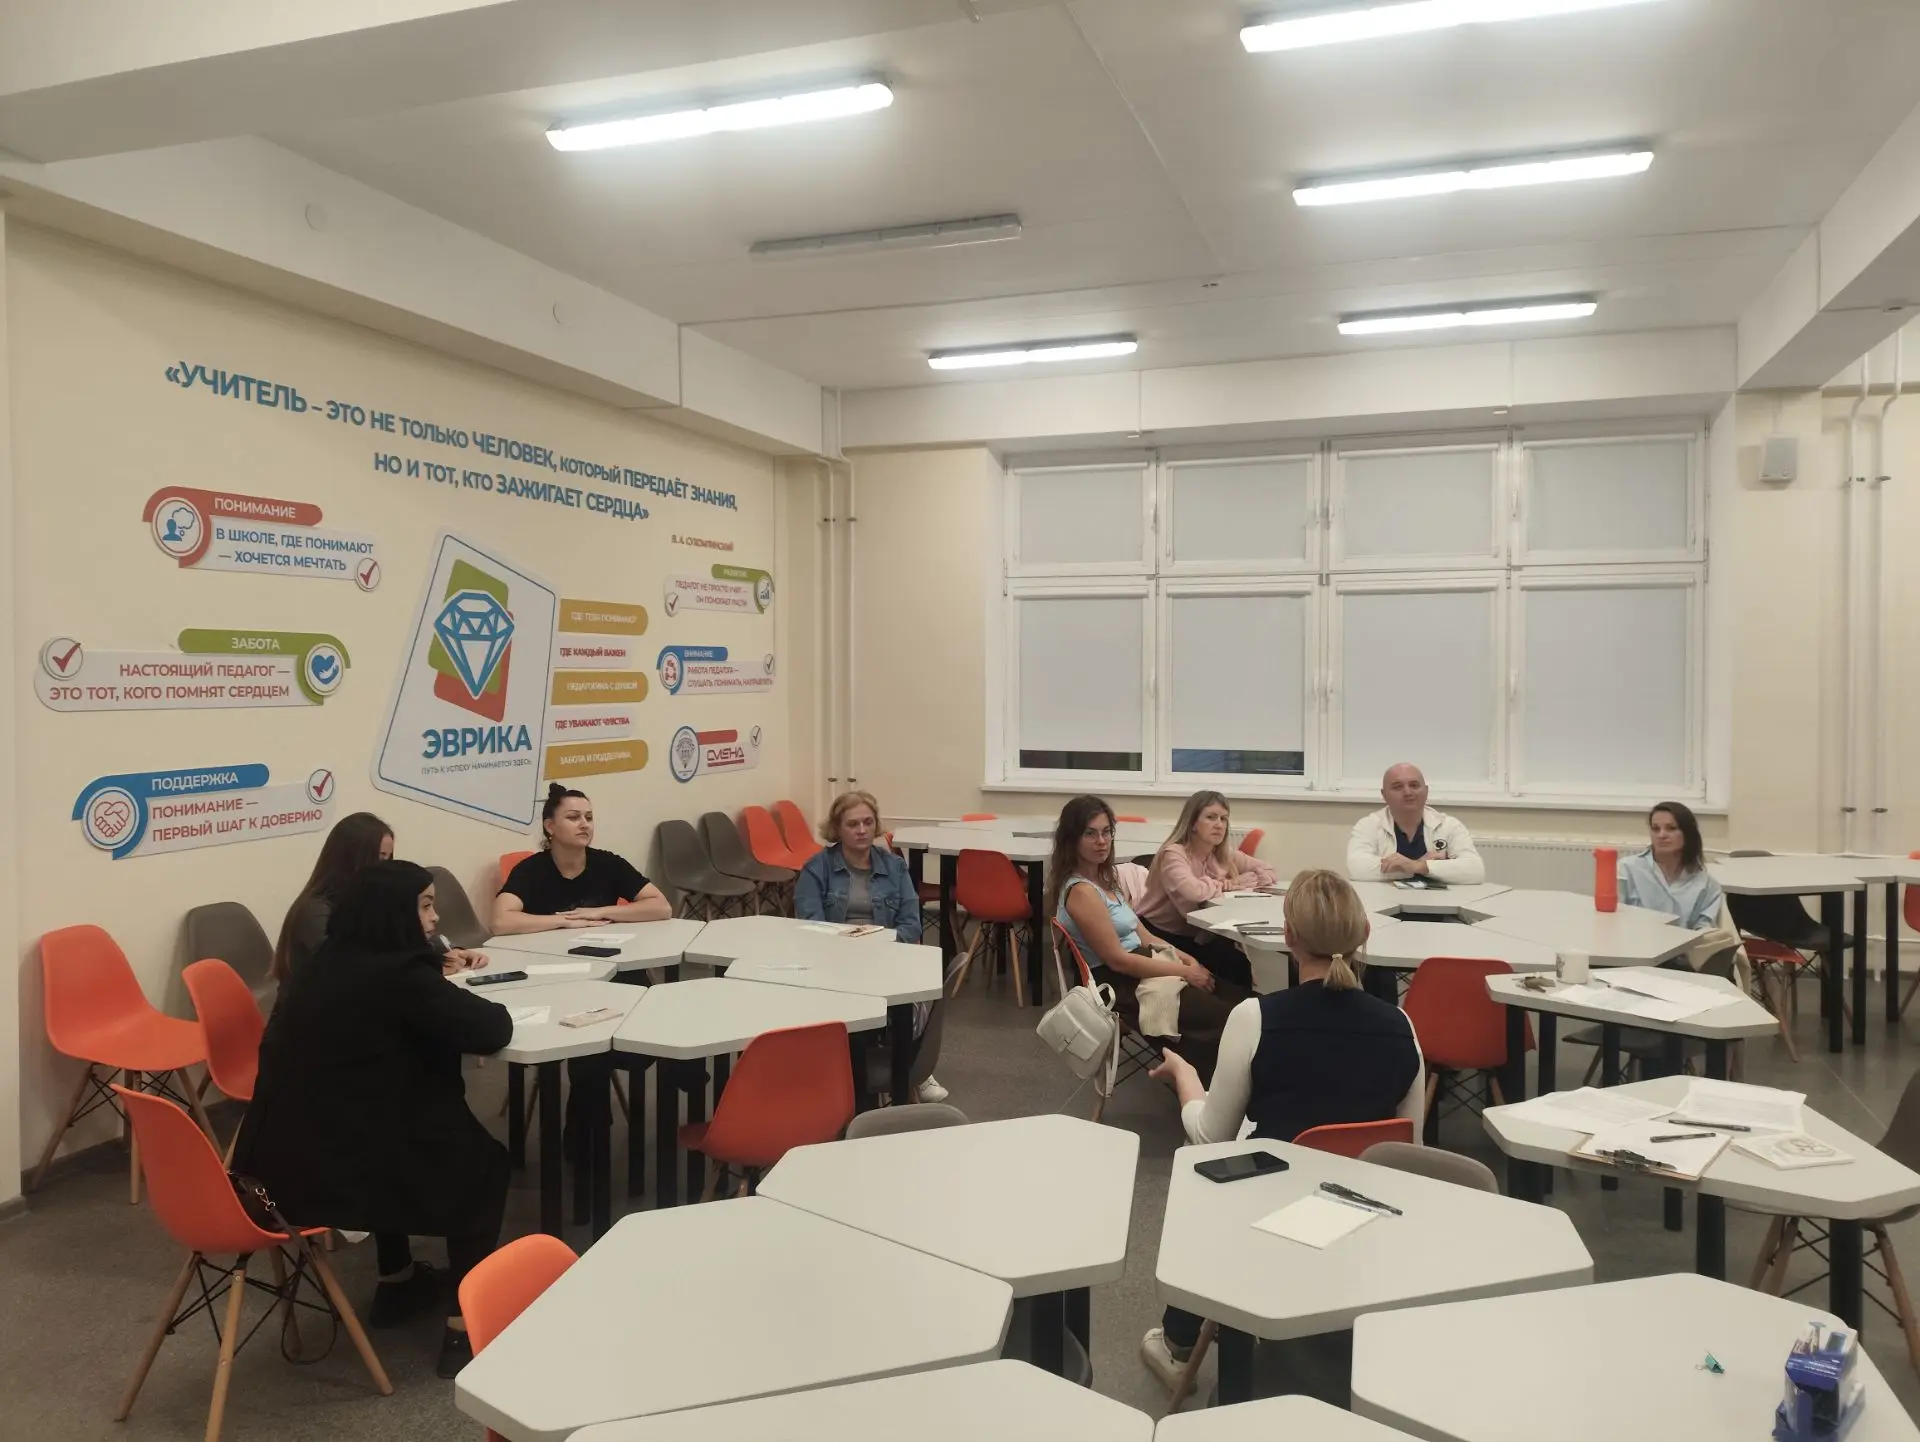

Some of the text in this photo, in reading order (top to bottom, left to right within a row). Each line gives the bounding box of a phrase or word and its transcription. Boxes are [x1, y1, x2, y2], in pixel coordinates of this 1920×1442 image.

[165, 361, 307, 412] «УЧИТЕЛЬ
[326, 400, 365, 426] ЭТО
[371, 410, 396, 433] НЕ
[399, 417, 469, 449] ТОЛЬКО
[472, 431, 558, 472] ЧЕЛОВЕК,
[559, 455, 621, 483] КОТОРЫЙ
[624, 469, 689, 500] ПЕРЕДАЁТ
[690, 486, 738, 511] ЗНАНИЯ,
[374, 452, 650, 521] НО И ТОТ, КТО ЗАЖИГАЕТ СЕРДЦА»
[214, 498, 297, 519] ПОНИМАНИЕ
[216, 528, 374, 554] В ШКОЛЕ, ГДЕ ПОНИМАЮТ
[234, 551, 291, 567] ХОЧЕТСЯ
[293, 556, 347, 571] МЕЧТАТЬ
[231, 637, 281, 650] ЗАБОТА
[560, 647, 572, 657] ГДЕ
[119, 662, 213, 677] НАСТОЯЩИЙ
[216, 665, 276, 678] ПЕДАГОГ
[50, 686, 290, 702] ЭТО ТОТ, КОГО ПОМНЯТ СЕРДЦЕМ
[555, 720, 567, 730] ГДЕ
[422, 724, 533, 759] ЭВРИКА
[152, 772, 239, 791] ПОДДЕРЖКА
[152, 798, 243, 820] ПОНИМАНИЕ
[152, 808, 323, 842] ПЕРВЫЙ ШАГ К ДОВЕРИЮ
